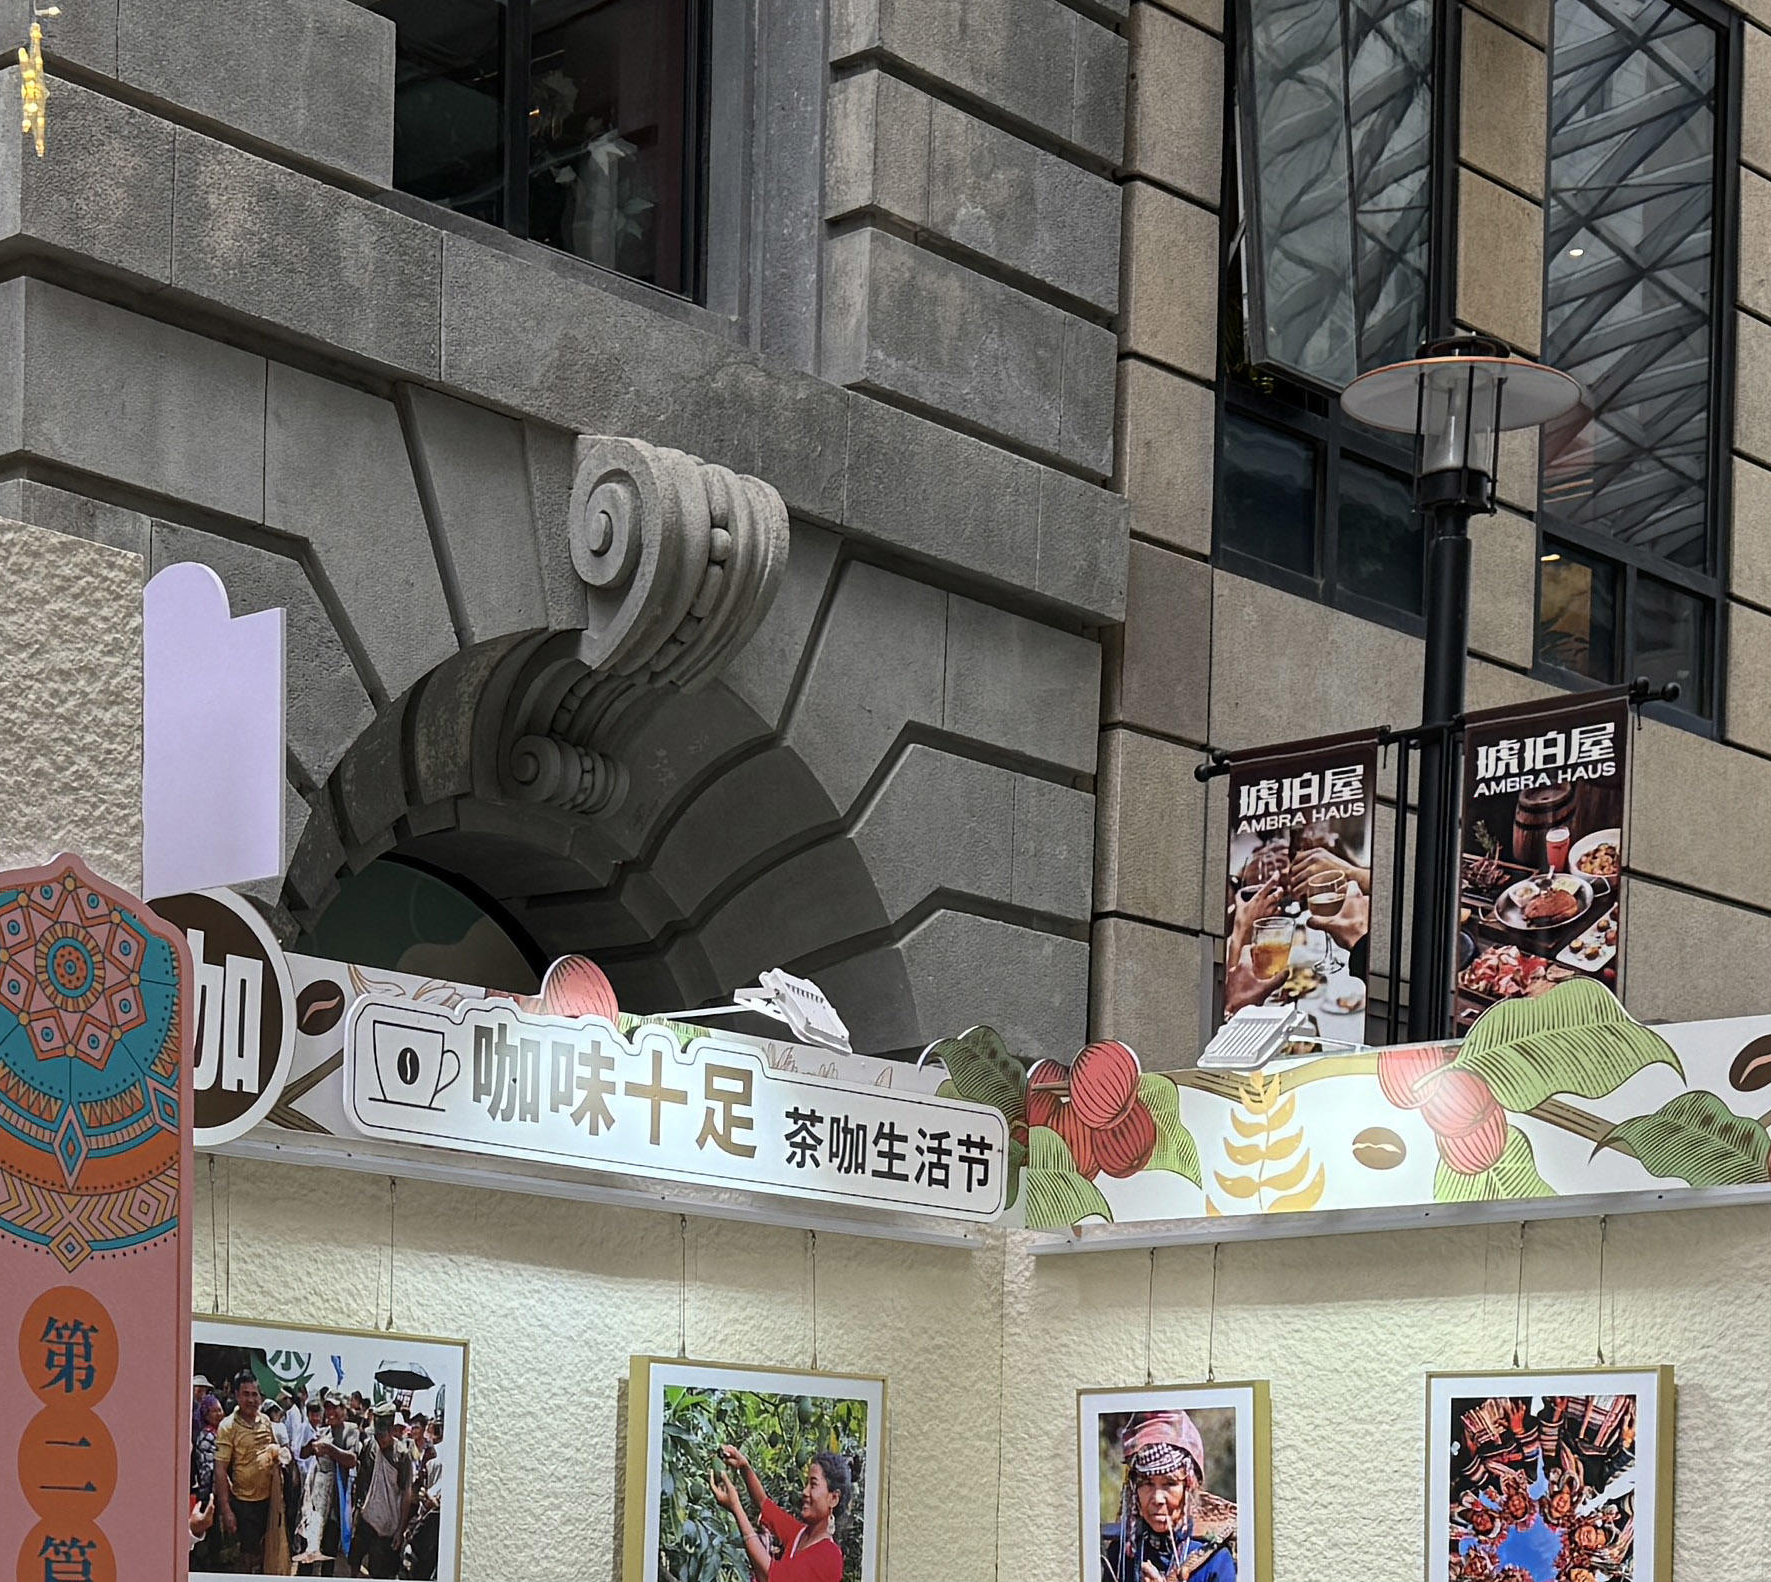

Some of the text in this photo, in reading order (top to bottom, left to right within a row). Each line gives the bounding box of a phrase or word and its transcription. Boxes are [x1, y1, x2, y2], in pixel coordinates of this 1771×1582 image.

[1476, 722, 1615, 780] 琥珀屋
[1238, 765, 1364, 818] 琥珀屋
[1474, 761, 1616, 798] AMBRA HAUS
[1236, 801, 1365, 834] AMBRA HAUS
[473, 1023, 994, 1194] 咖味十足 茶咖生活节
